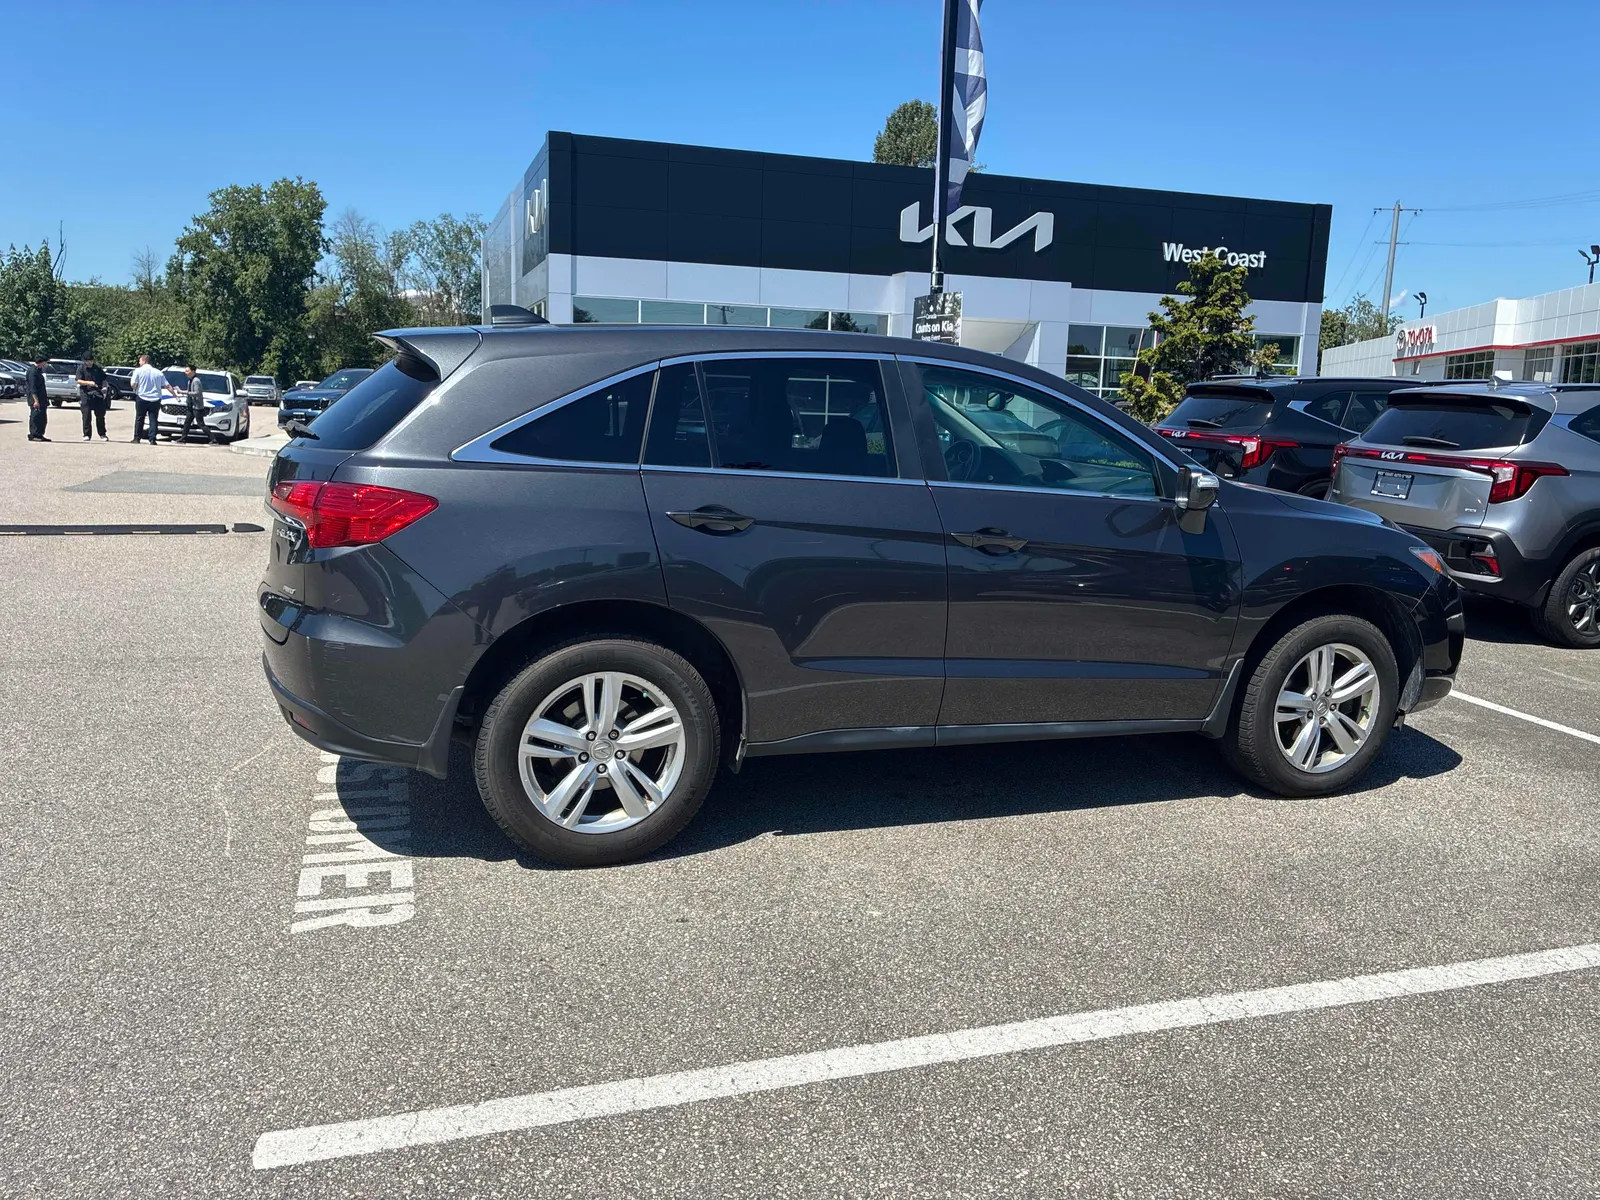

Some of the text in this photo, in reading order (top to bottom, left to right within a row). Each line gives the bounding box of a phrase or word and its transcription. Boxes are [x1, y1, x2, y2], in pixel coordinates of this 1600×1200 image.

[900, 201, 1054, 252] KIA
[1214, 246, 1267, 268] Coast
[915, 320, 954, 334] Counts on Kia
[1407, 326, 1433, 346] TOYOTA
[1380, 451, 1405, 460] KIA
[290, 750, 416, 934] STOMER
